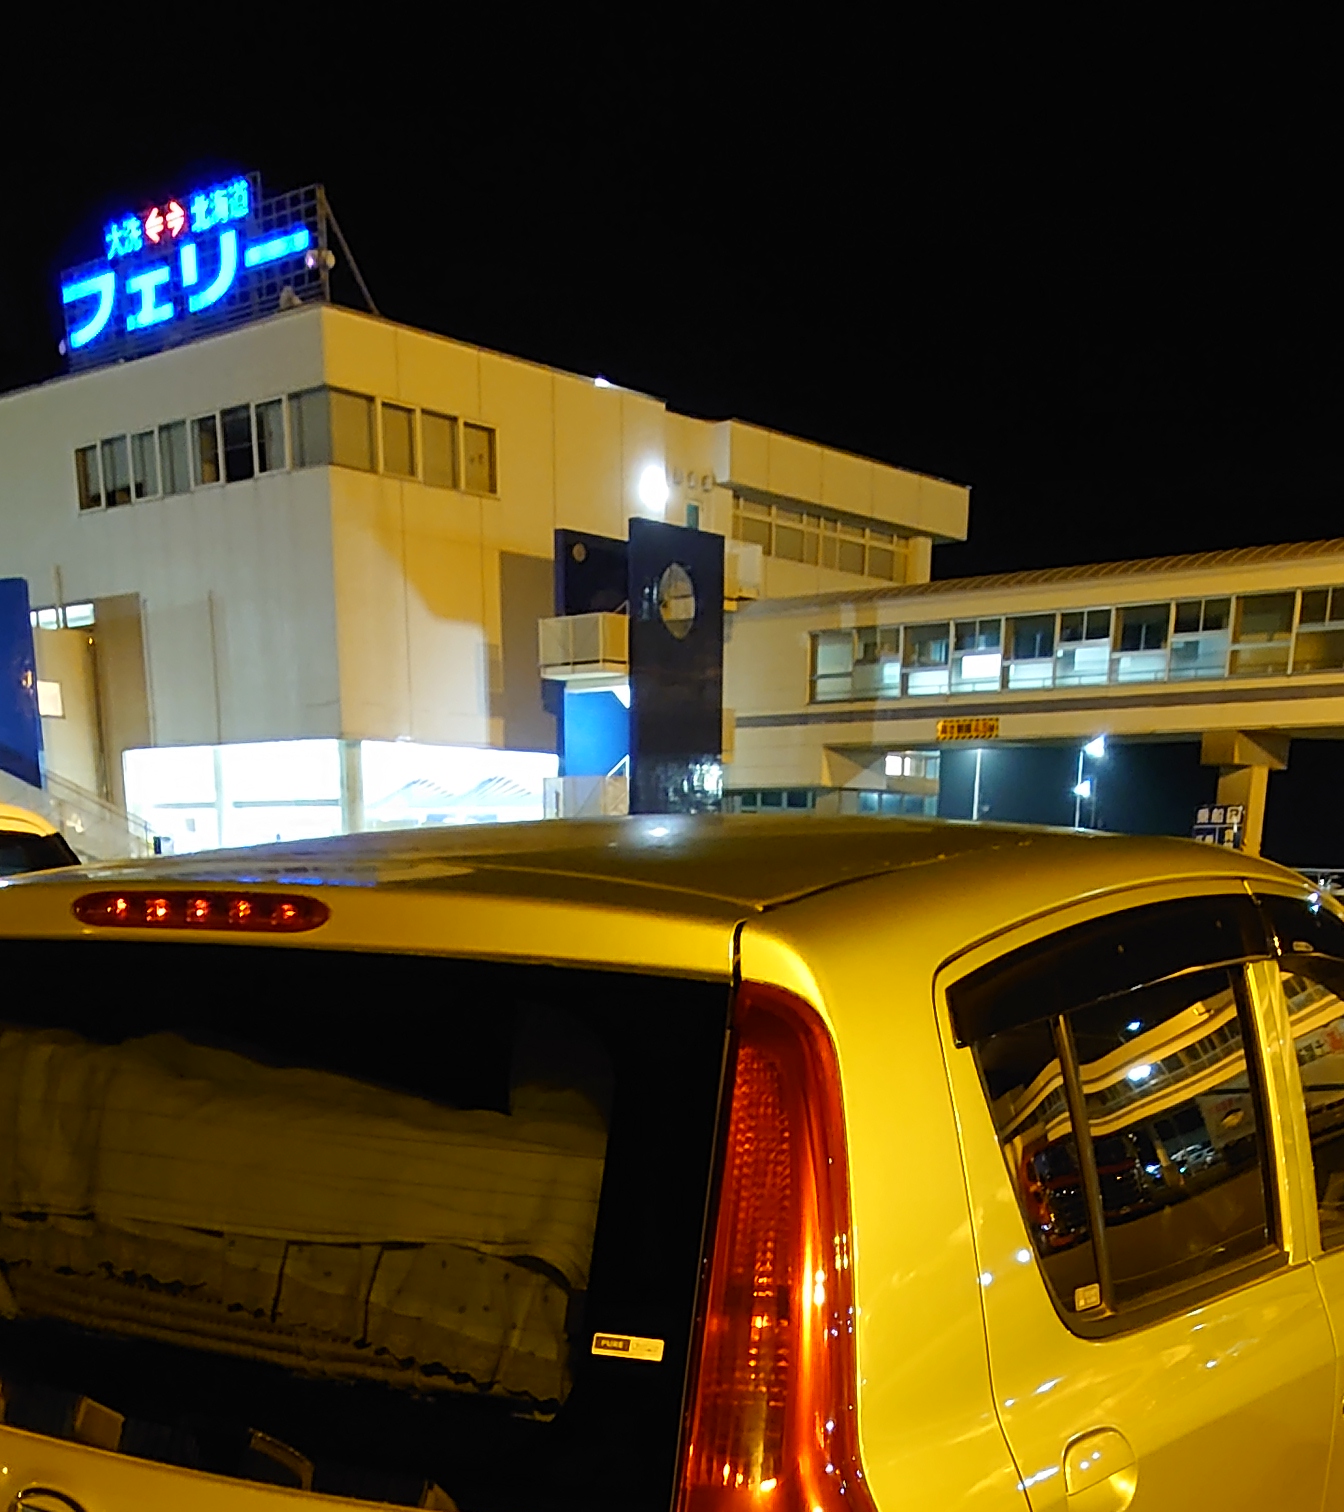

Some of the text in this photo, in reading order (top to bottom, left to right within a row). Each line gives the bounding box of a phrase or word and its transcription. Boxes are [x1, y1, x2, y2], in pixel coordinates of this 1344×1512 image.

[191, 178, 248, 232] 北海道
[63, 229, 309, 348] フェリー
